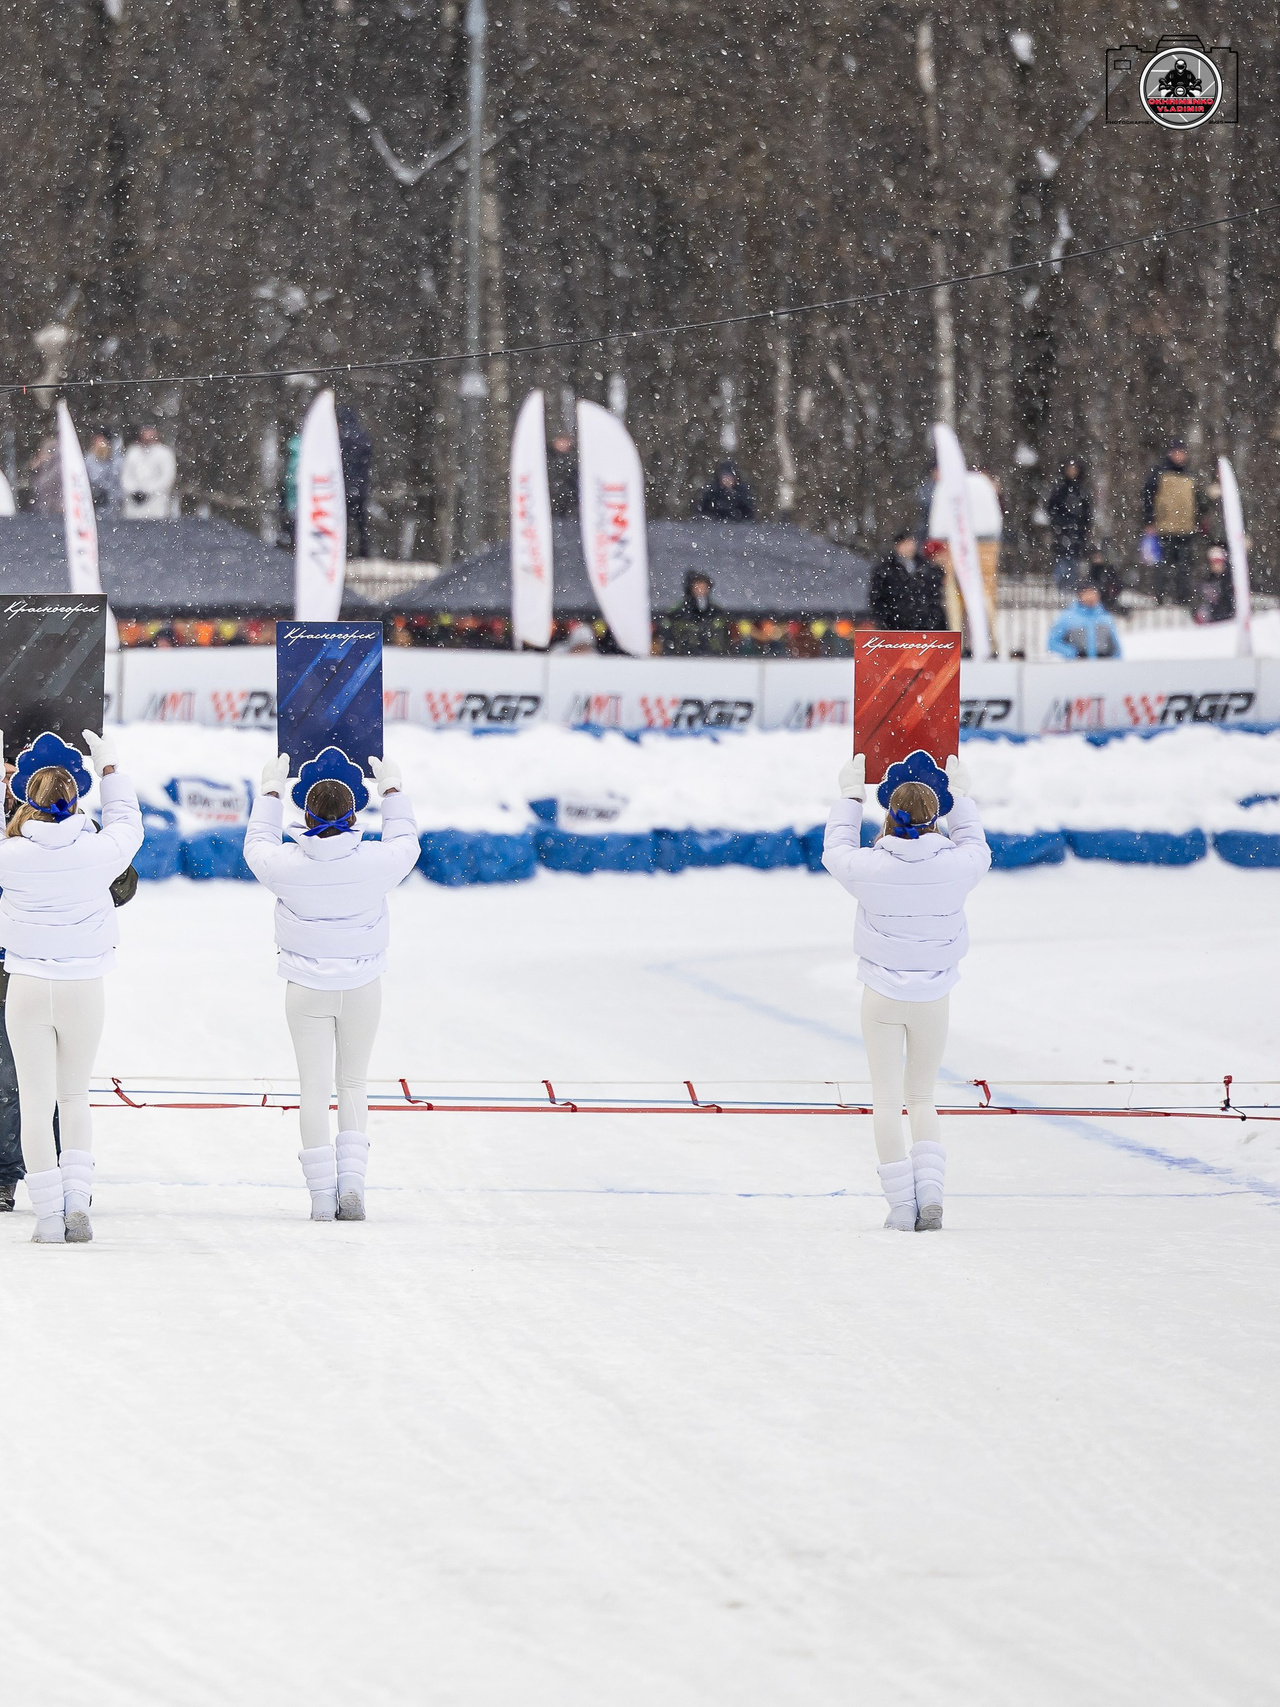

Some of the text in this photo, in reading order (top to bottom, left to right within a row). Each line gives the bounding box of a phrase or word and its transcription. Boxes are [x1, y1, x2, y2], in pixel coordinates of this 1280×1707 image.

[4, 600, 100, 620] Красногорск
[283, 627, 376, 647] Красногорск
[861, 636, 955, 656] Красногорск
